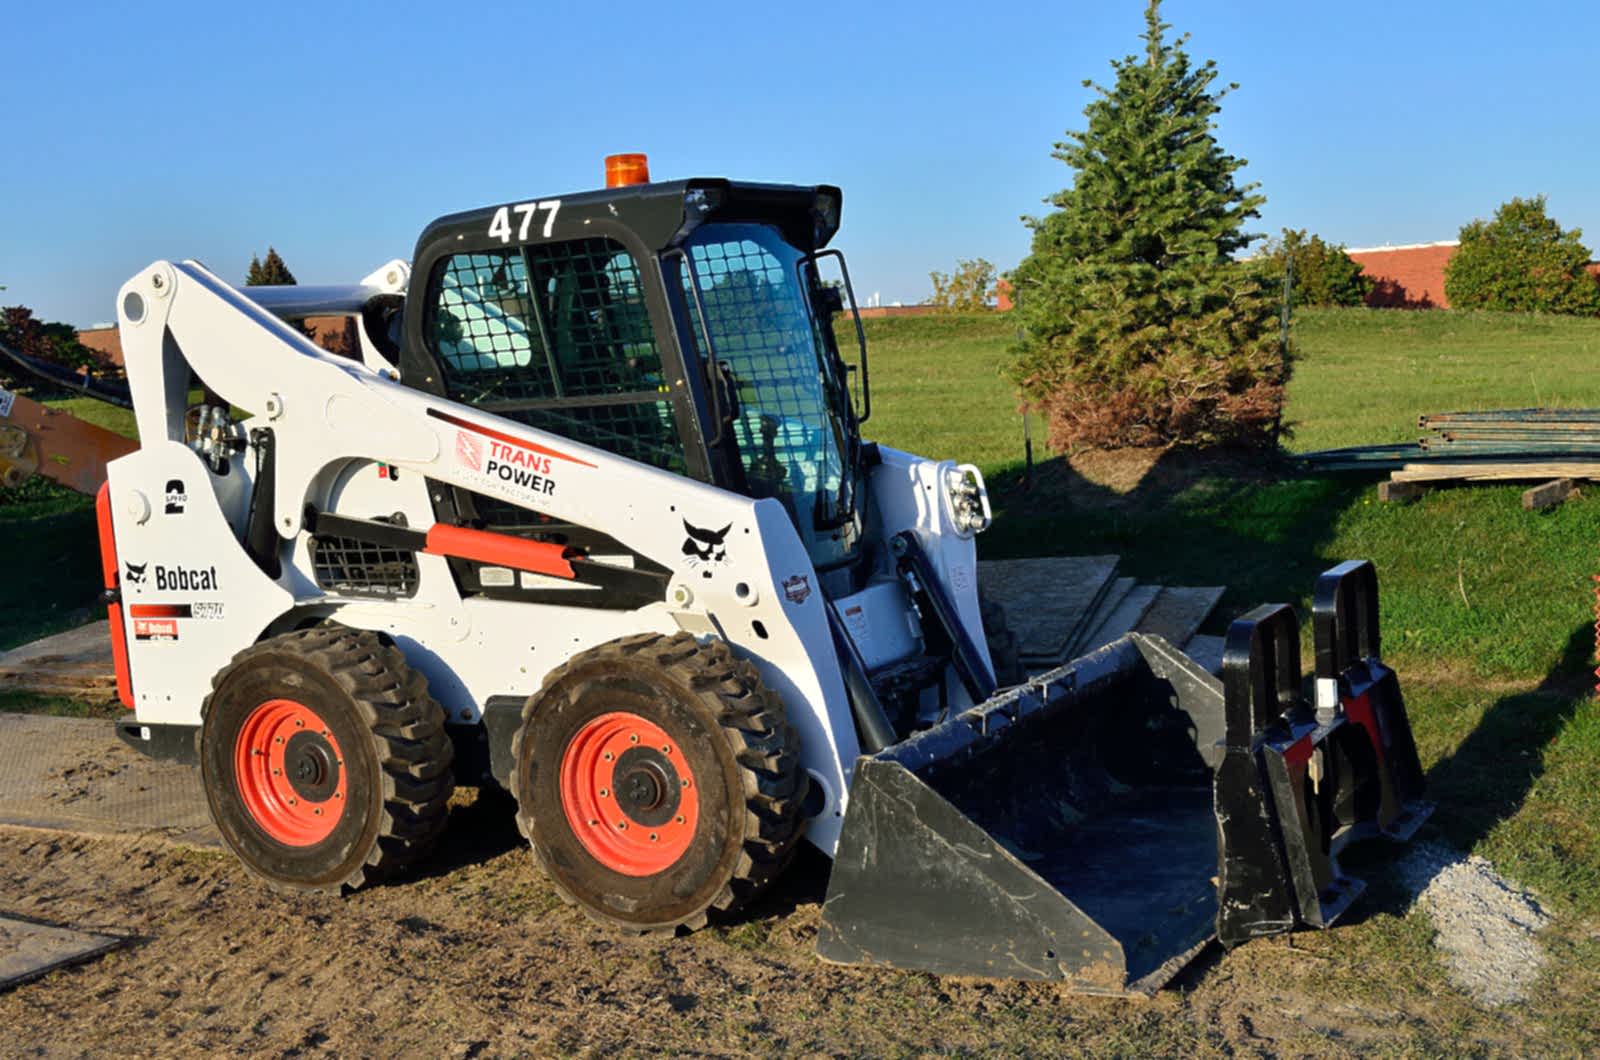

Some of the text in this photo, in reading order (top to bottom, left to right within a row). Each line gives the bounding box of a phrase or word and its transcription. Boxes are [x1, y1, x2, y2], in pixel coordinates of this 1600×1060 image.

[488, 199, 561, 243] 477
[490, 441, 552, 475] TRANS
[486, 460, 556, 496] POWER
[155, 565, 217, 591] Bobcat
